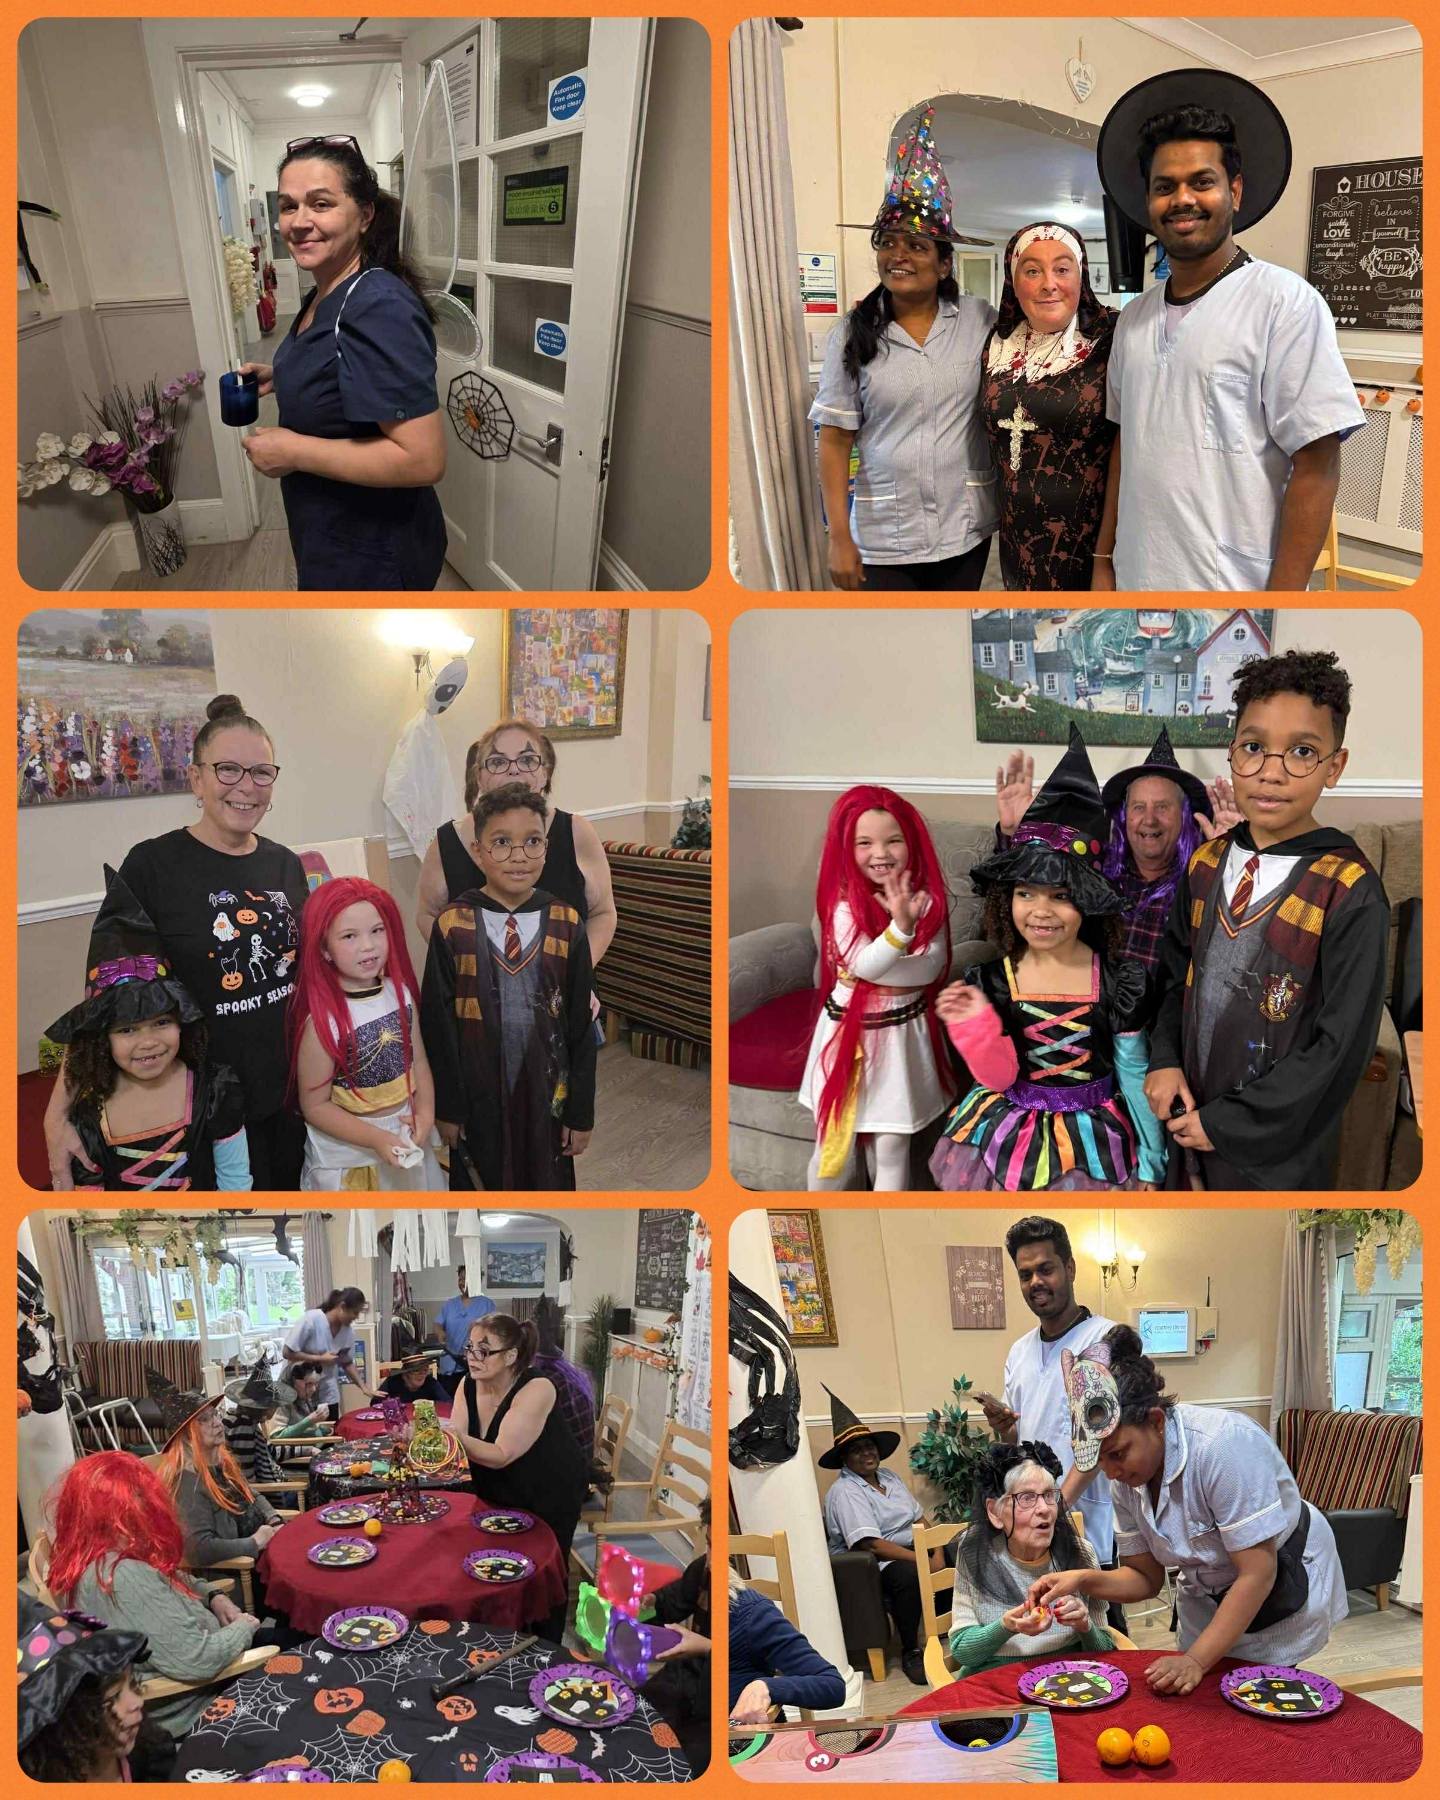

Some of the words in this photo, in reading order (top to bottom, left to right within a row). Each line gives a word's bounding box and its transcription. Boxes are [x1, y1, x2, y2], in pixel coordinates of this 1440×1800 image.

[553, 82, 582, 96] Automatic
[554, 96, 566, 104] Fire
[566, 91, 580, 100] door
[552, 104, 566, 113] Keep
[567, 99, 582, 108] clear
[1355, 166, 1423, 189] HOUSE
[1322, 210, 1355, 218] FORGIVE
[1374, 203, 1413, 217] believe
[1386, 218, 1396, 226] IN
[1323, 228, 1351, 238] LOVE
[1384, 251, 1402, 261] BE
[1378, 259, 1405, 275] happy
[1333, 283, 1371, 292] please
[1325, 293, 1356, 301] thank
[1340, 304, 1359, 312] you
[216, 995, 263, 1016] SPOOKY
[266, 982, 295, 1004] SEASO
